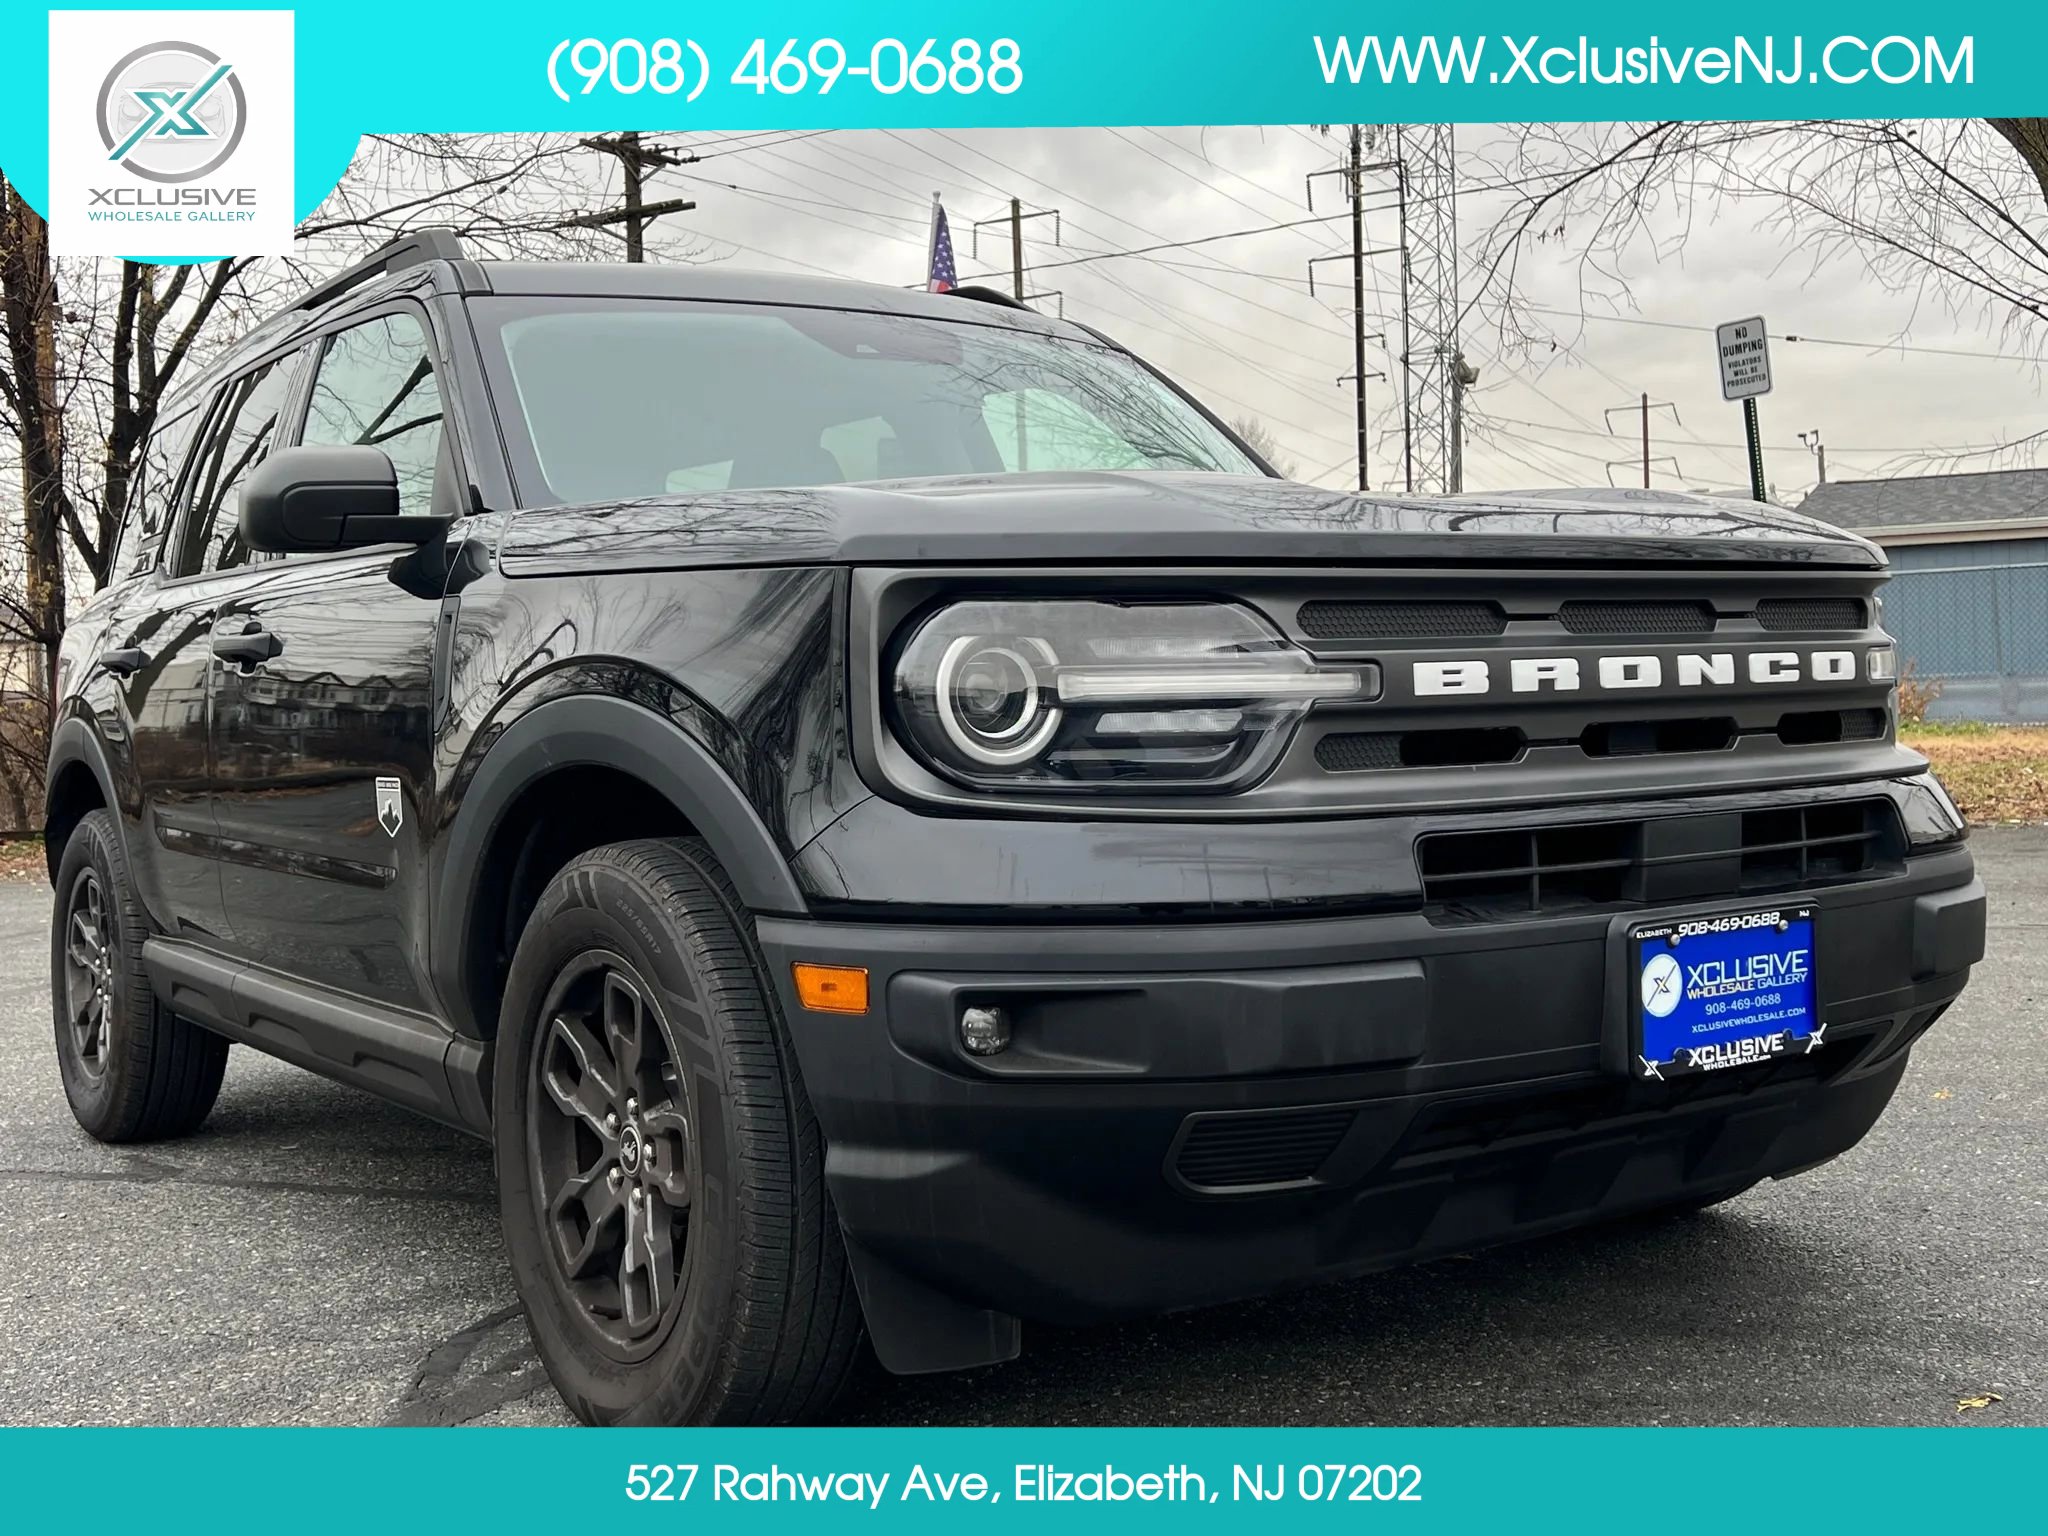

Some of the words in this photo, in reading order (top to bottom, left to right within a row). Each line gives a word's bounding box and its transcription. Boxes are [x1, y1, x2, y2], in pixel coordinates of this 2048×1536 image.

[1735, 326, 1748, 340] NO
[1722, 339, 1763, 357] DUMPING
[1728, 356, 1762, 369] VIOLATORS
[1733, 368, 1748, 377] WILL
[1750, 366, 1758, 374] BE
[1727, 373, 1767, 388] PROSECUTED
[1413, 650, 1857, 697] BRONCO
[1636, 927, 1672, 939] ELIZABETH
[1678, 911, 1781, 938] 908-469-0688
[1799, 910, 1810, 918] NJ
[1687, 949, 1809, 988] XCLUSIVE
[1687, 979, 1755, 1000] WHOLESALE
[1757, 972, 1808, 989] GALLERY
[1705, 993, 1781, 1015] 908-469-0688
[1692, 1007, 1806, 1033] XCLUSIVEWHOLESALE.COM
[1688, 1032, 1784, 1067] XCLUSIVE
